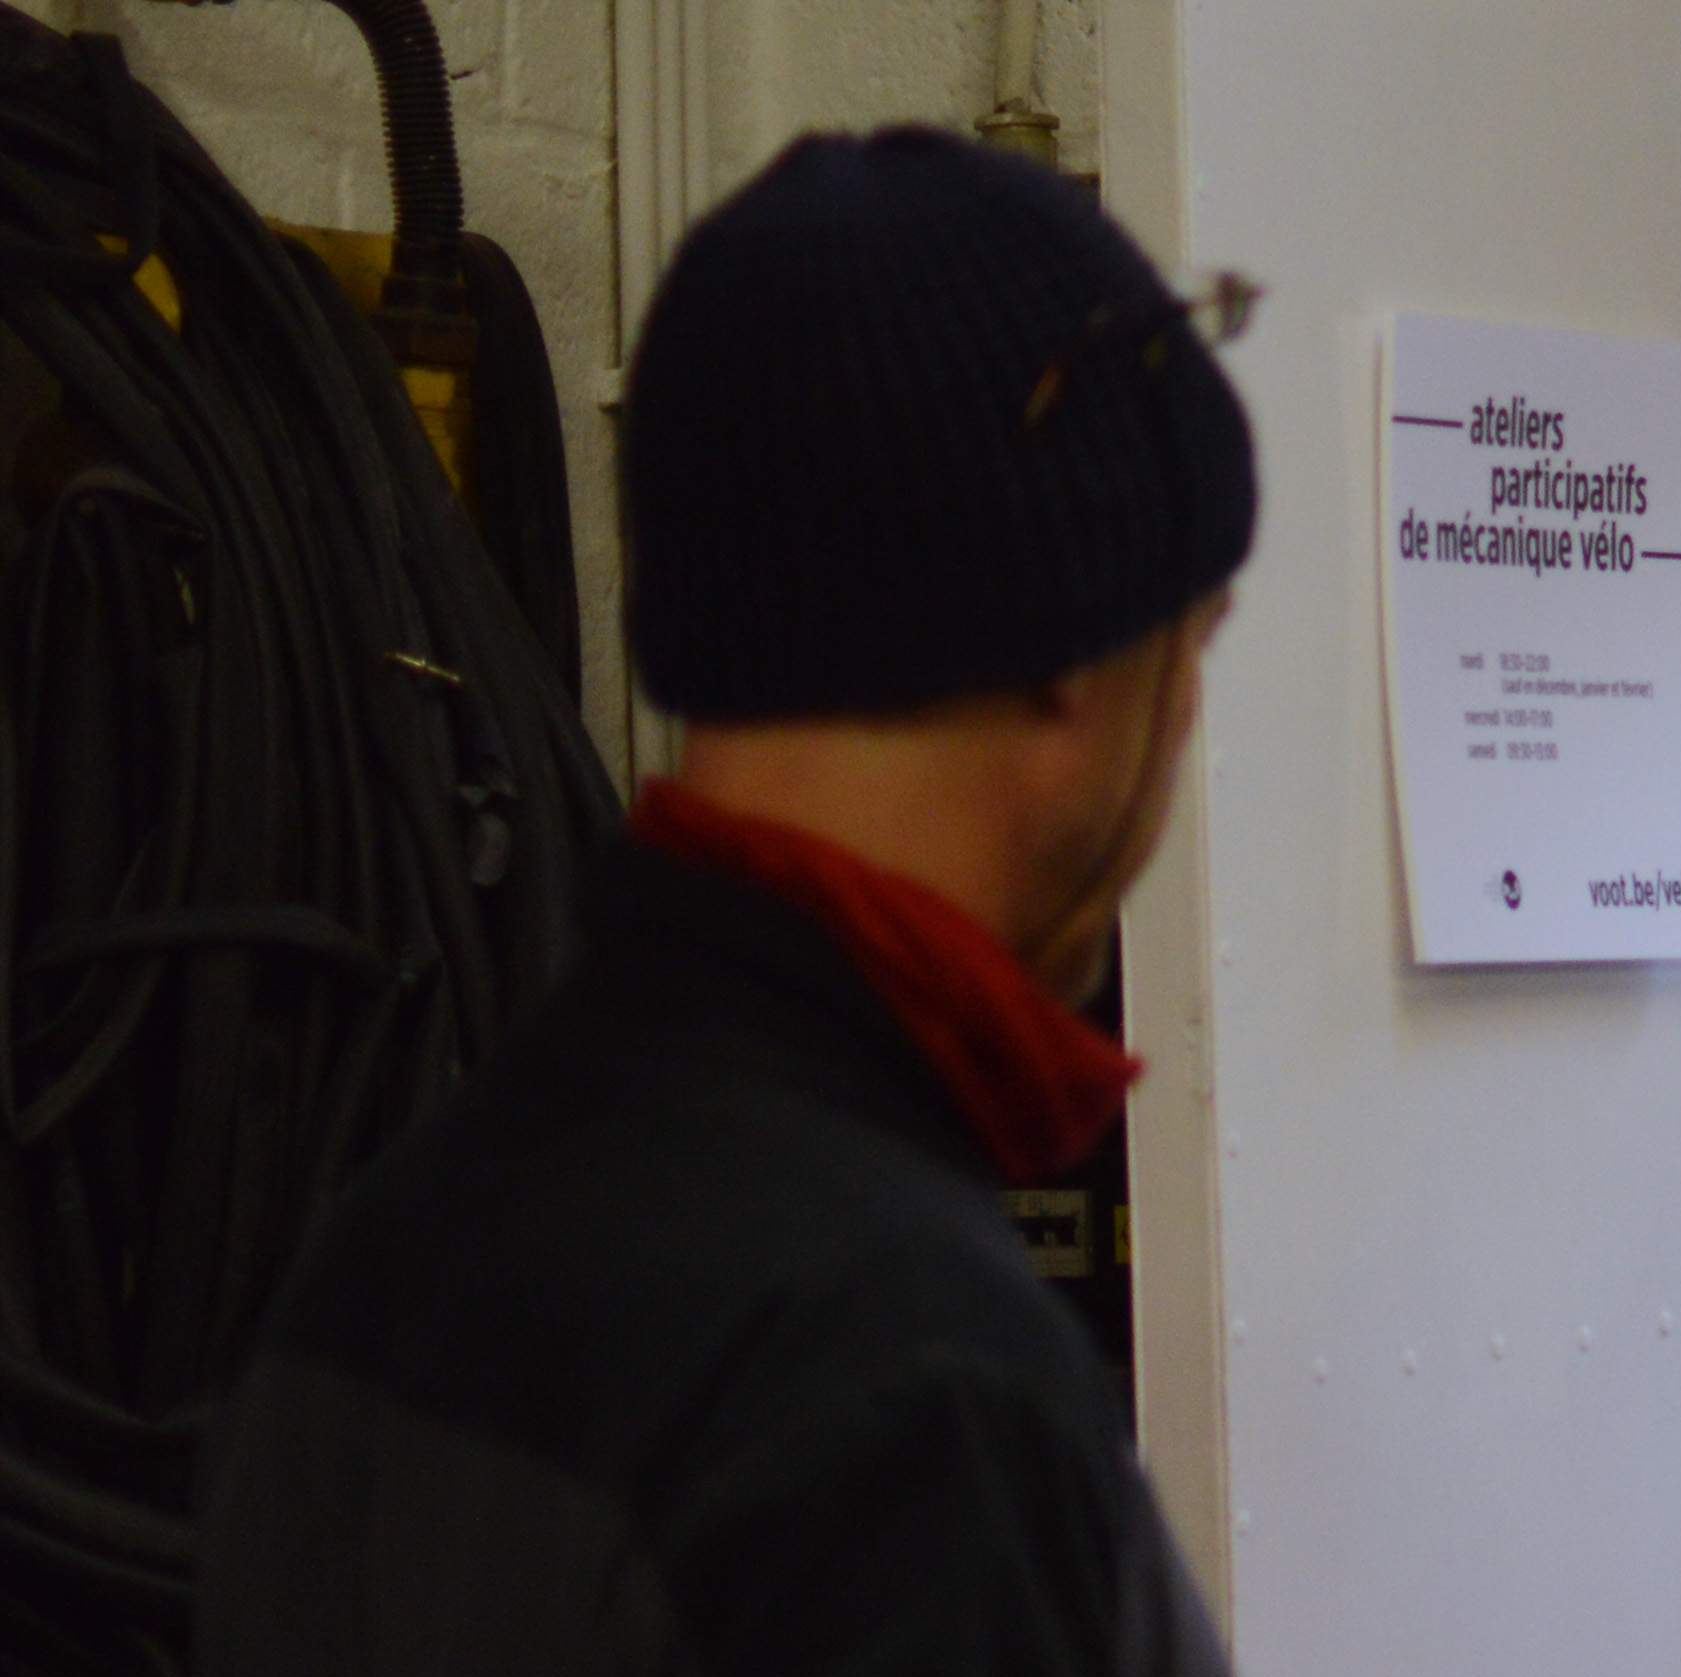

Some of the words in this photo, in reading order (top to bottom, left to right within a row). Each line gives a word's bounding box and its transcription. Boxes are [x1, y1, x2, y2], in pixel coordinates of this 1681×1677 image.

[1470, 396, 1564, 451] ateliers
[1491, 458, 1647, 520] participatifs
[1400, 506, 1429, 560] de
[1436, 510, 1572, 578] mécanique
[1580, 519, 1634, 572] vélo
